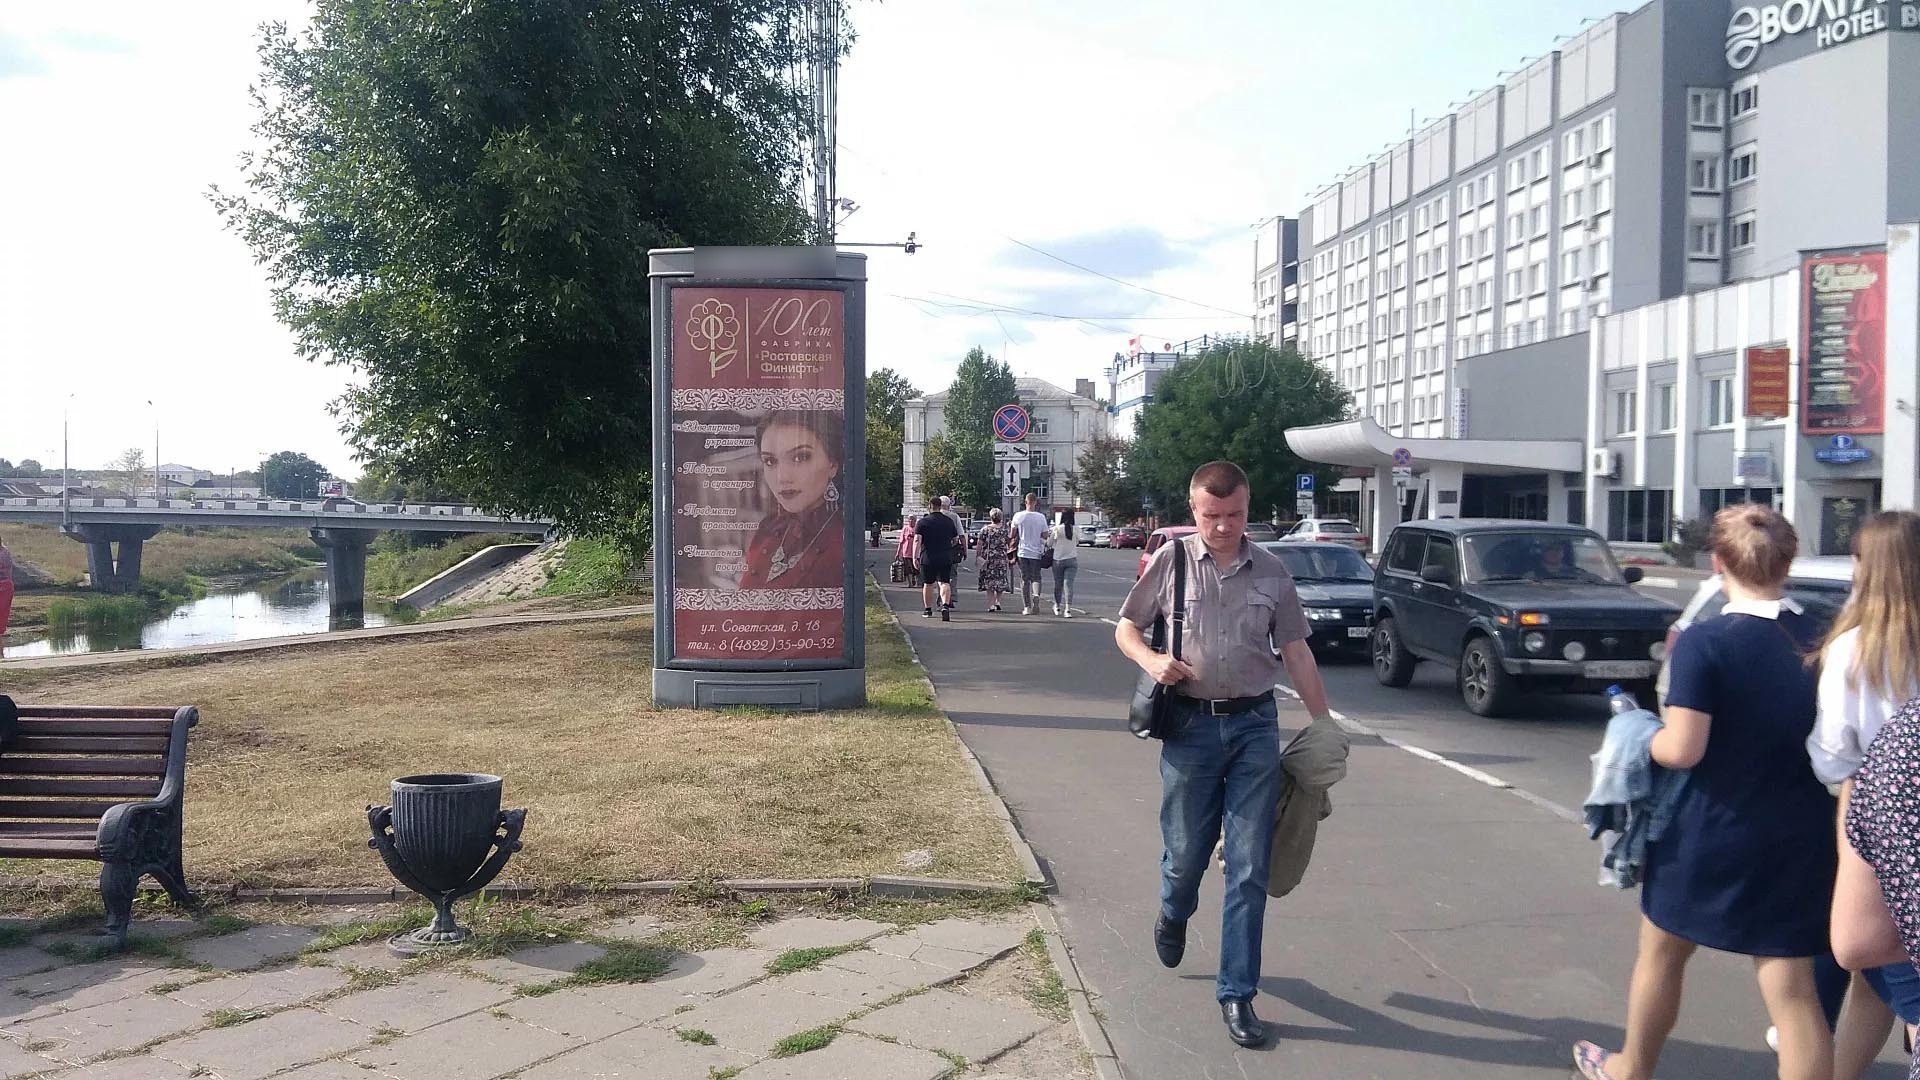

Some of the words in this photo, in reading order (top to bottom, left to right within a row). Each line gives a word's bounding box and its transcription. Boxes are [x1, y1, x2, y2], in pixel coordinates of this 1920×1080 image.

[1816, 6, 1886, 48] HOTEL
[755, 297, 831, 336] 100
[802, 325, 833, 337] лет
[704, 438, 755, 449] украшения
[682, 462, 727, 476] Подарки
[710, 480, 755, 490] сувениры
[1301, 476, 1311, 489] P
[701, 623, 718, 635] ул.
[722, 619, 787, 634] Советская,
[791, 621, 801, 632] д.
[805, 620, 821, 631] 18
